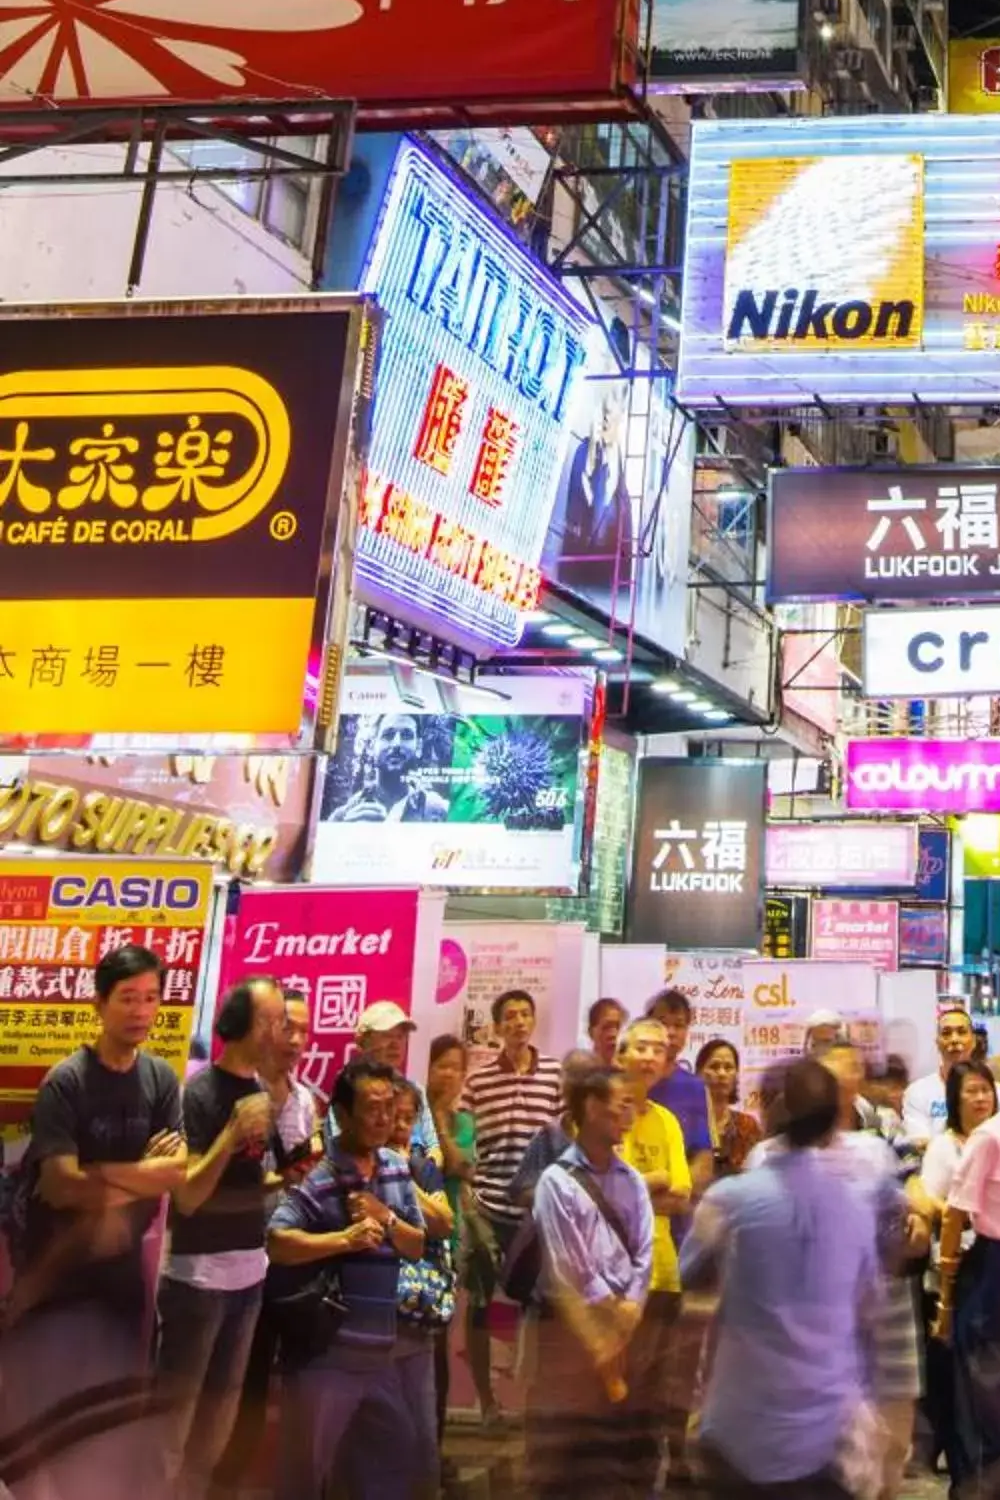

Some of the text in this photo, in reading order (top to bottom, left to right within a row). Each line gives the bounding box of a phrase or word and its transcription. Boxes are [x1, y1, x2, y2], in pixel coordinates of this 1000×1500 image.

[726, 286, 918, 343] Nikon
[7, 515, 190, 544] CAFÉ DE CORAL
[864, 554, 978, 579] LUKFOOK
[651, 820, 748, 871] 六福
[51, 876, 201, 911] CASIO
[650, 872, 743, 894] LUKFOOK
[753, 972, 797, 1008] csl.
